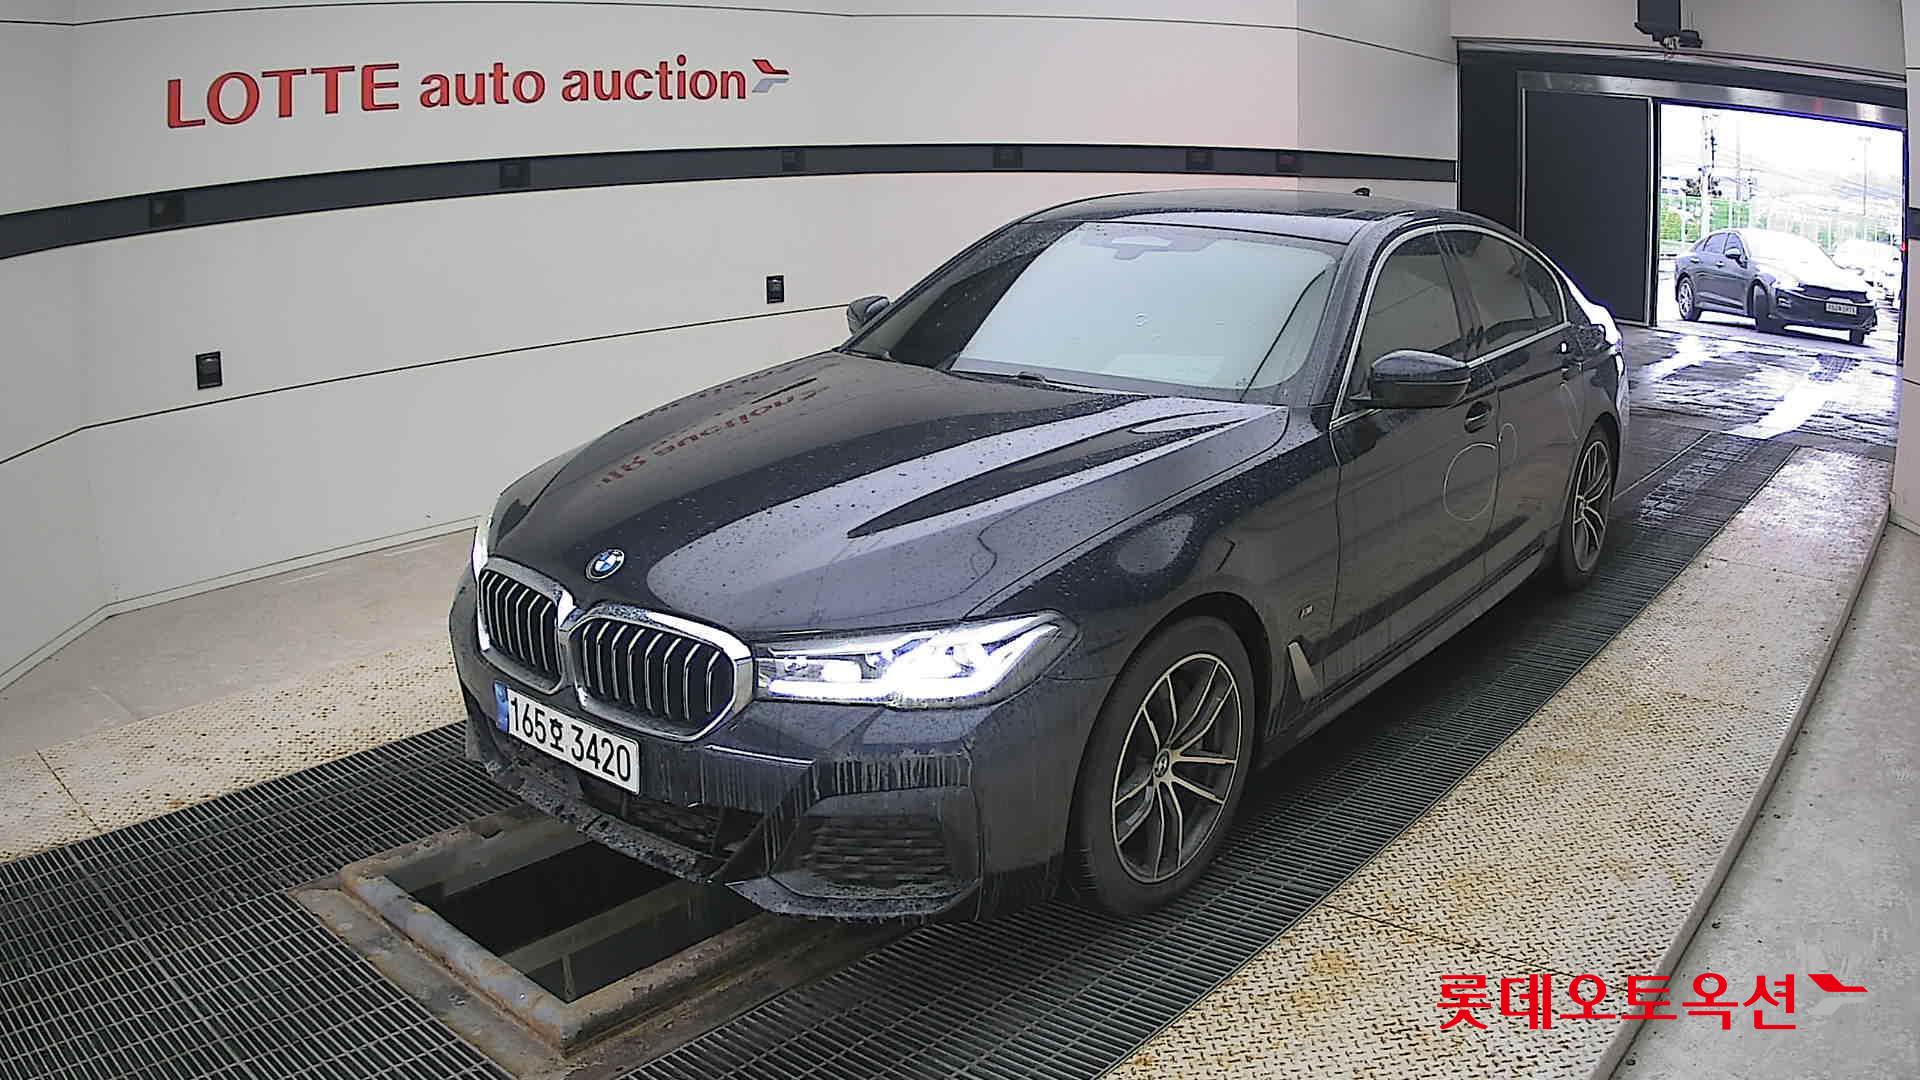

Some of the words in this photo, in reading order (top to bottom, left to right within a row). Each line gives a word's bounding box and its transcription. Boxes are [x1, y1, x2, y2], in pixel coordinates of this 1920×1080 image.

[168, 64, 399, 128] LOTTE
[420, 62, 545, 108] auto
[562, 54, 747, 101] auction
